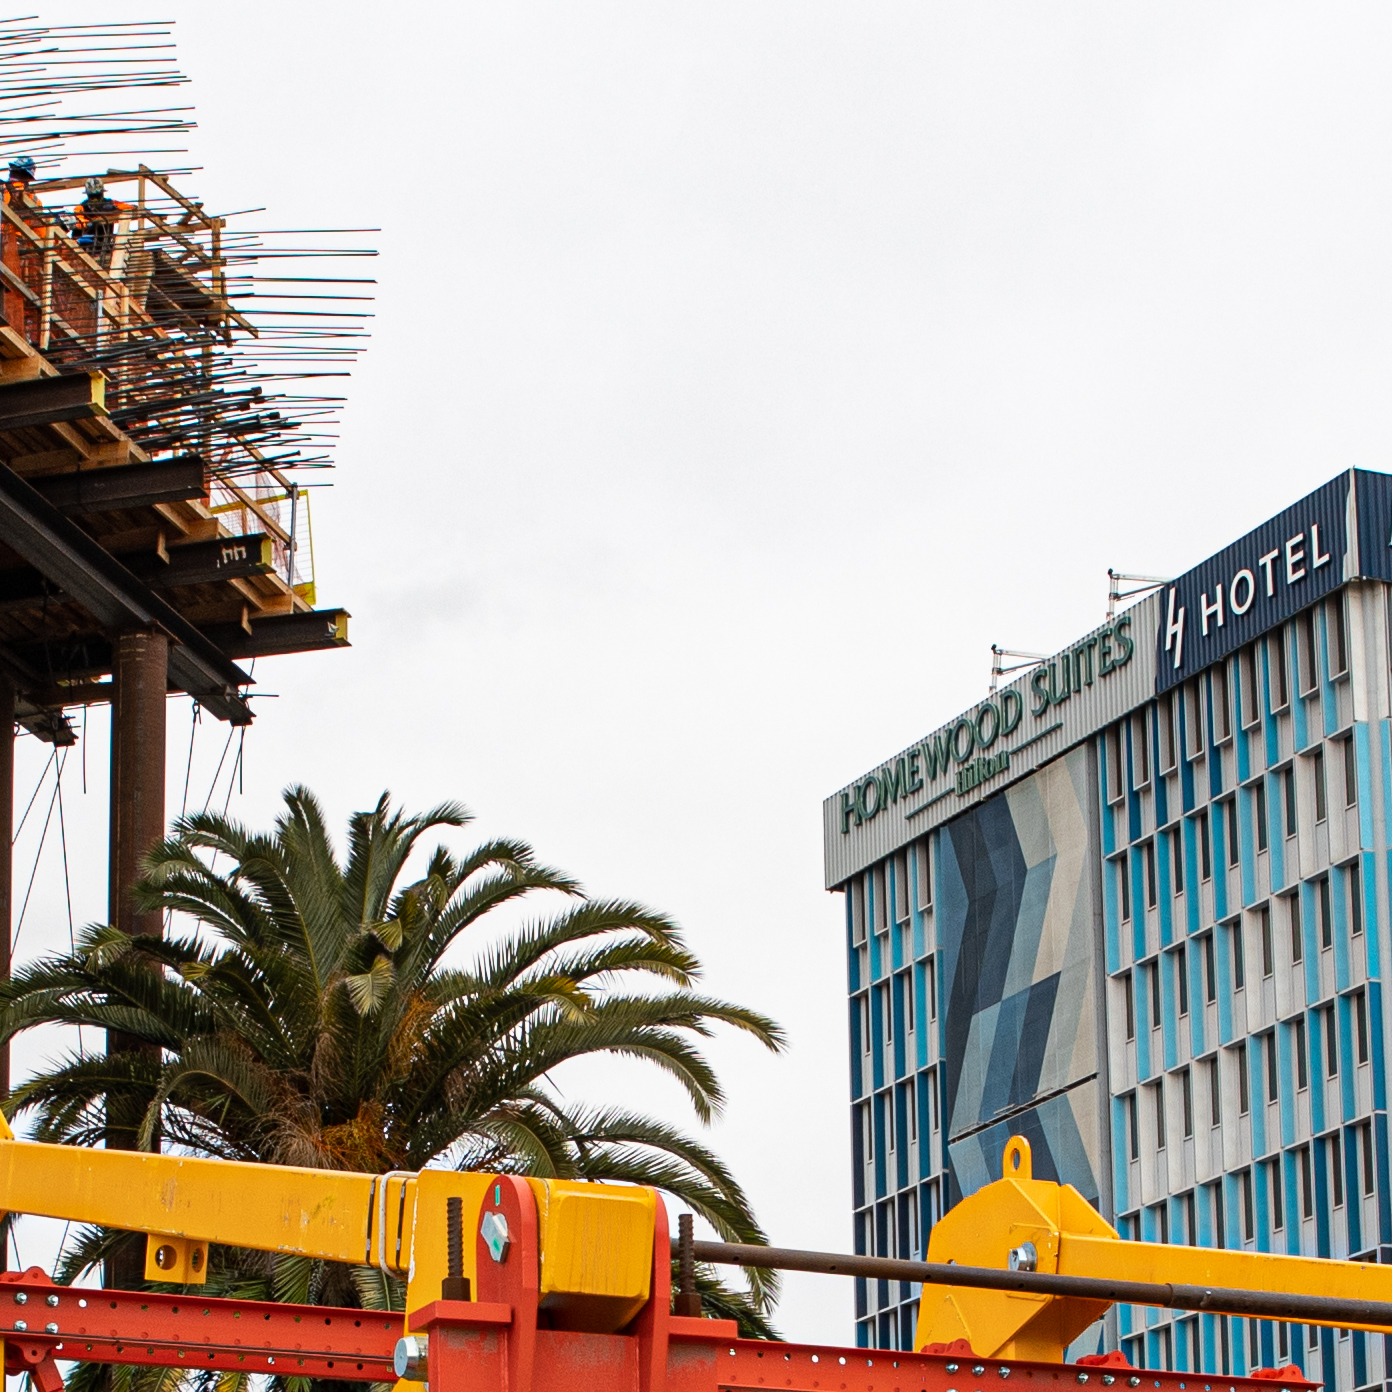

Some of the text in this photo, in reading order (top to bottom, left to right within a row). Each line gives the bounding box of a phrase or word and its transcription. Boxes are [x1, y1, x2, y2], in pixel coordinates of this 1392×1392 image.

[1201, 523, 1330, 637] HOTEL
[840, 616, 1134, 834] HOMEWOOD SUITES
[955, 751, 1009, 797] Hilton
